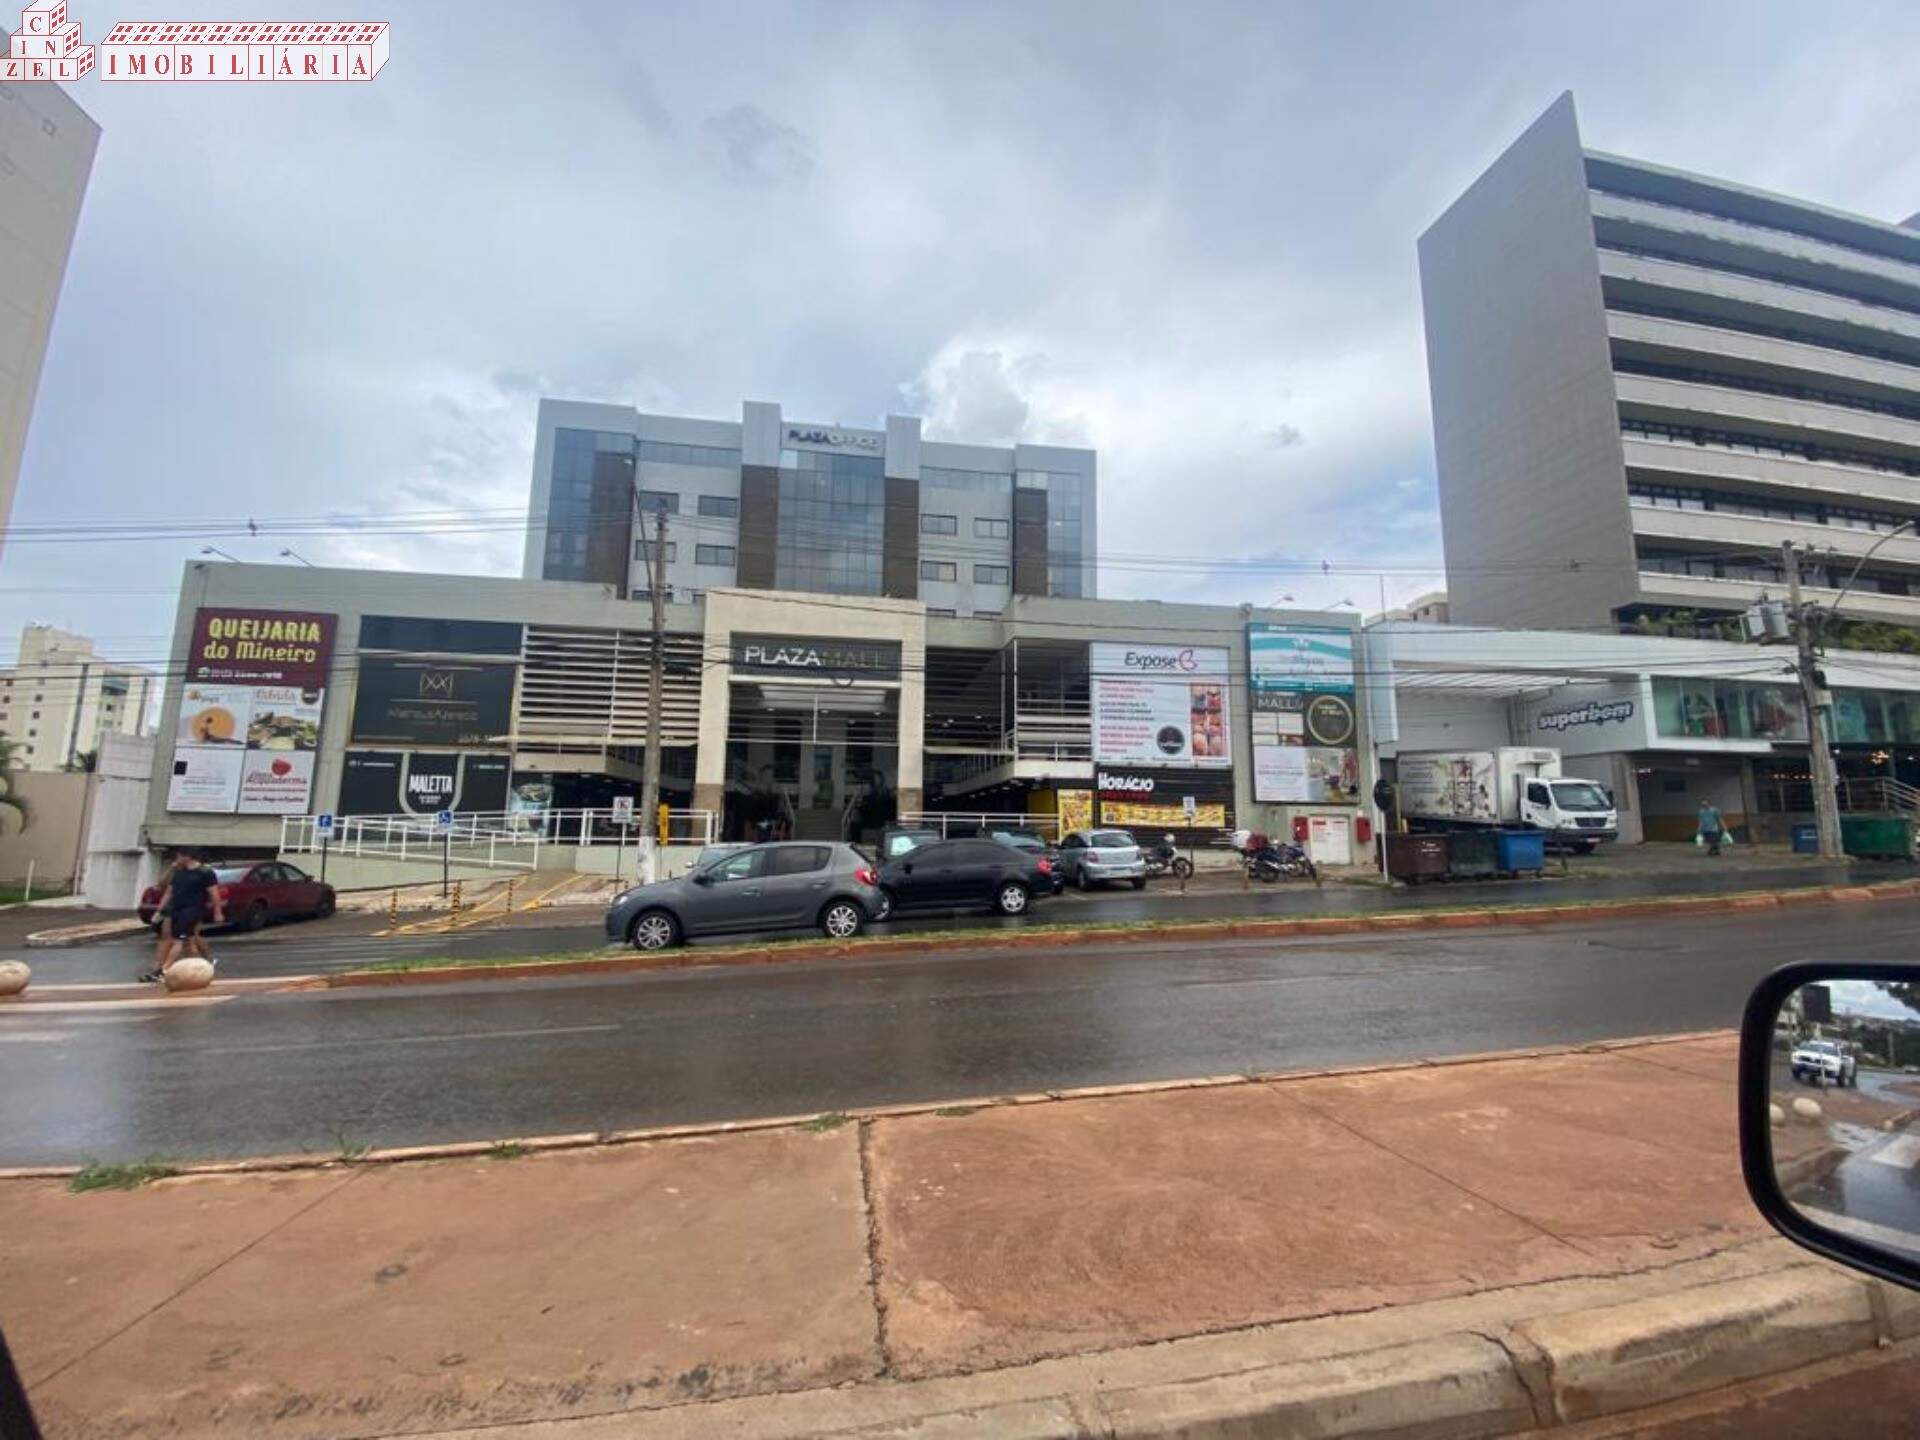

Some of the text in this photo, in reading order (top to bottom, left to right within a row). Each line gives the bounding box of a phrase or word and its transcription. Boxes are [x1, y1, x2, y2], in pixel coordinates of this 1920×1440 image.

[209, 617, 321, 643] QUEIJARIA
[204, 640, 316, 663] do Mineiro
[743, 645, 821, 667] PLAZA
[1124, 651, 1177, 671] Expose
[409, 773, 453, 794] MALETTA
